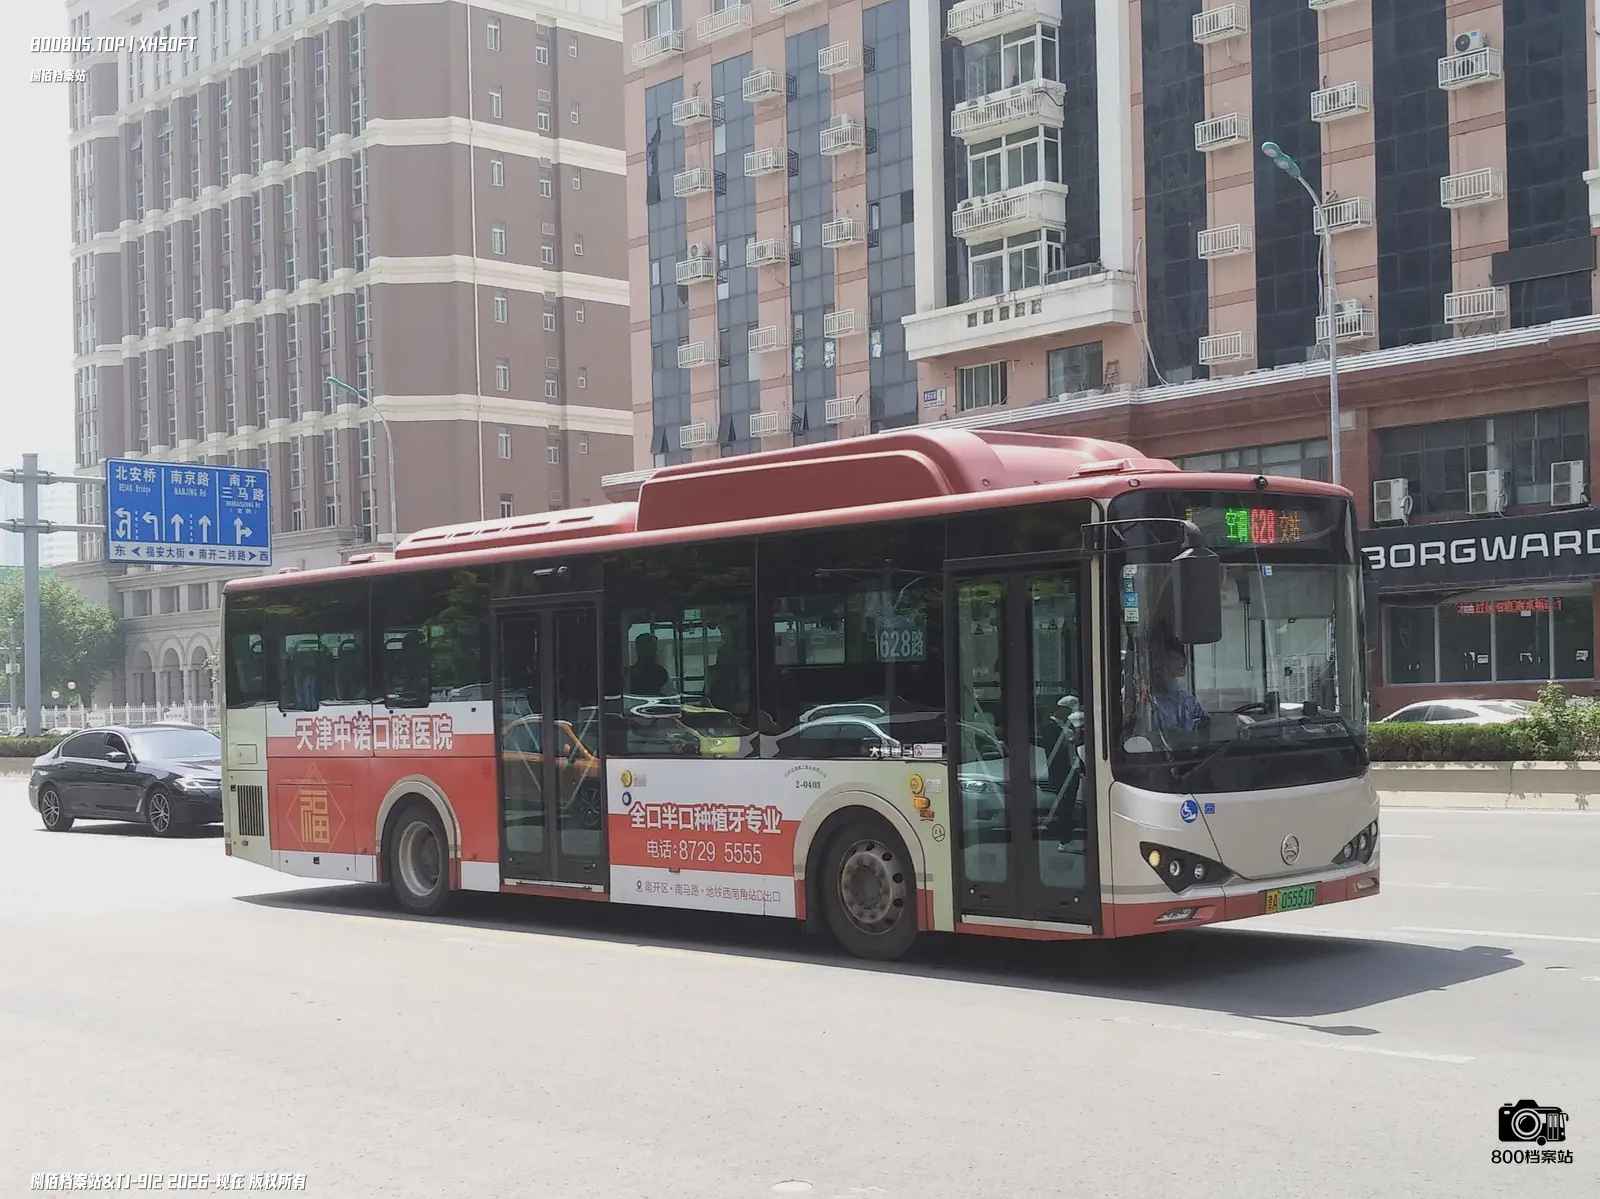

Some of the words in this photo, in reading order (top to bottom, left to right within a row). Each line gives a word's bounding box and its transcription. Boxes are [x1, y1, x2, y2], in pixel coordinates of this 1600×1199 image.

[115, 466, 157, 484] 北安桥
[171, 470, 210, 487] 南京路
[228, 473, 257, 488] 南开
[221, 487, 265, 502] 三马路
[115, 545, 126, 557] 东
[198, 549, 246, 561] 南开二纬路
[259, 551, 269, 561] 西
[880, 629, 924, 658] 628路
[296, 714, 453, 751] 天津中诺口腔医院
[629, 801, 782, 834] 全口半口种植牙专业
[724, 842, 763, 864] 5555
